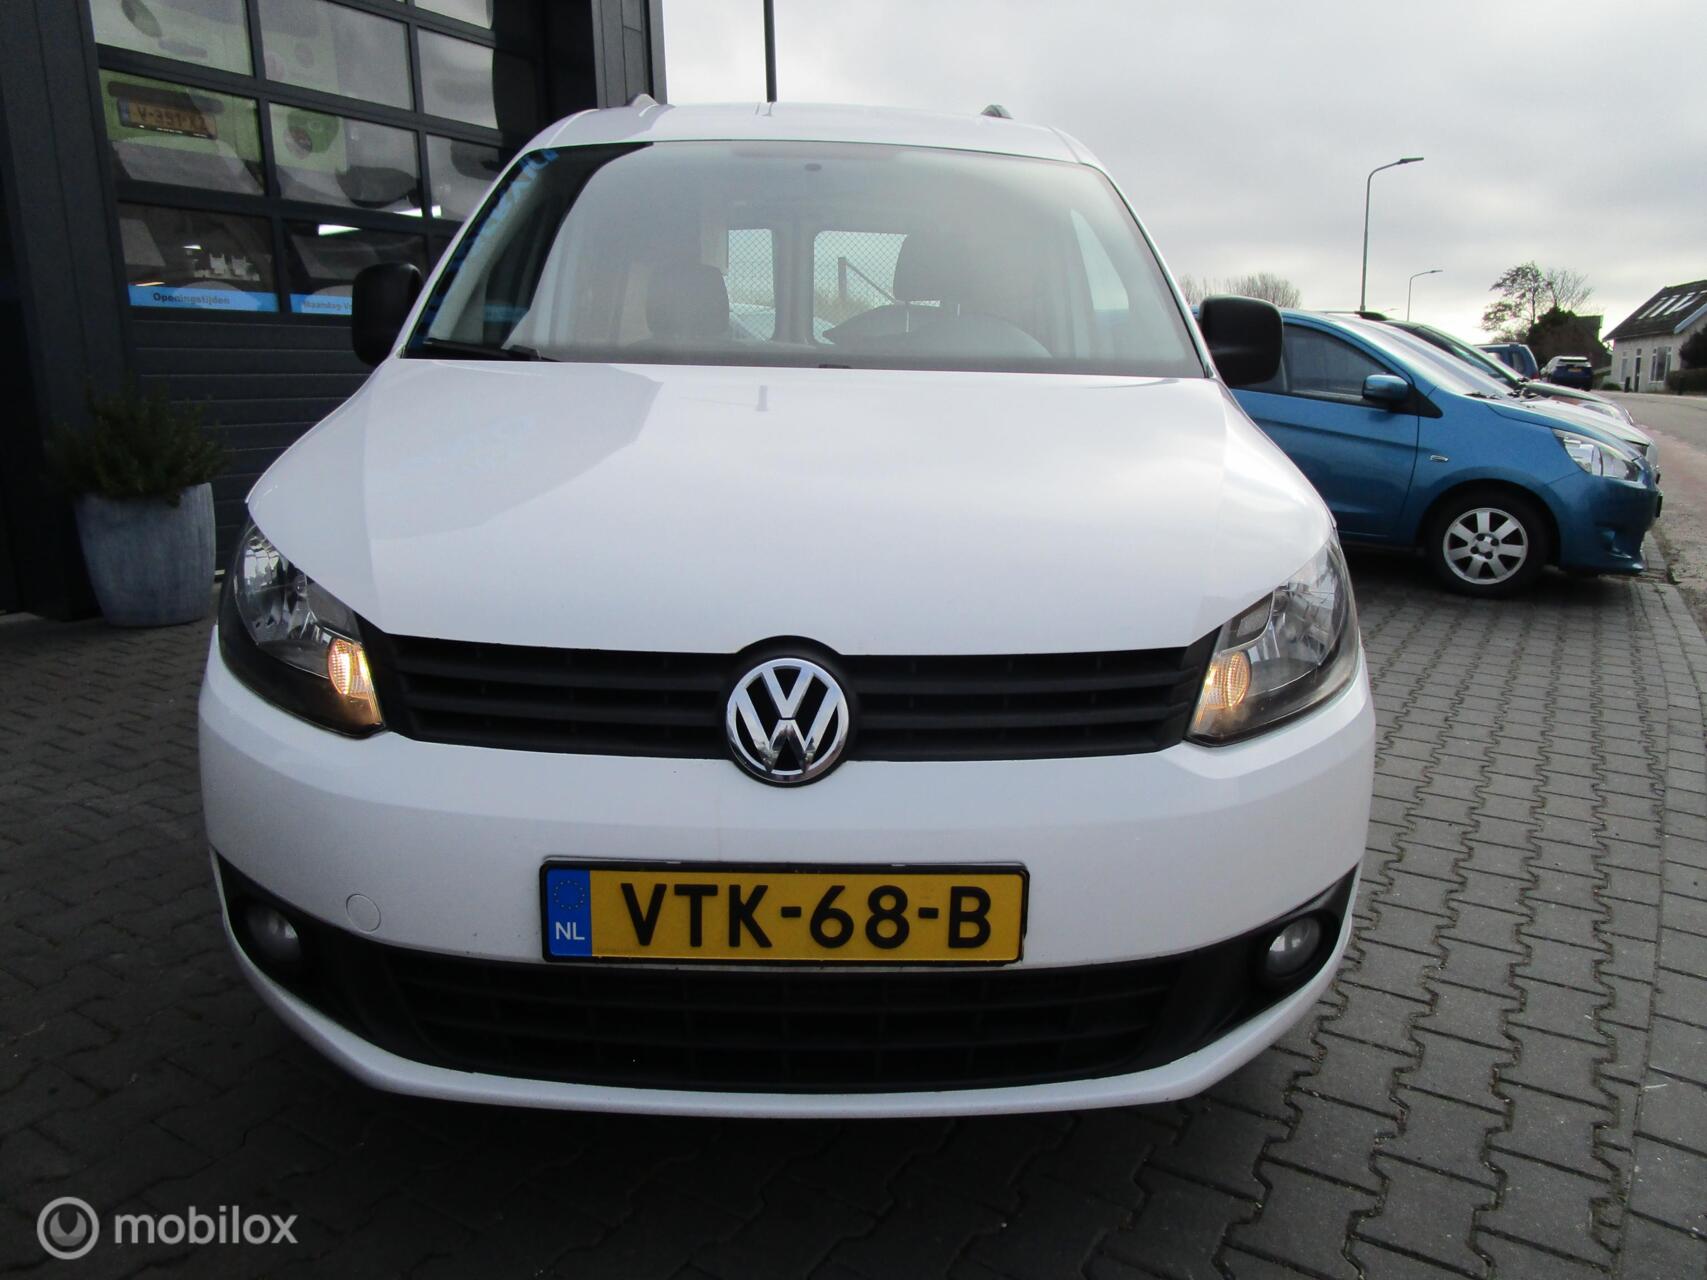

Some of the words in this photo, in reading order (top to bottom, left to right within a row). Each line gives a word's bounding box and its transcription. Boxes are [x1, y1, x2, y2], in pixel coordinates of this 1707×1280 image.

[152, 292, 230, 306] Openingstijden
[620, 882, 992, 950] VTK-68-B
[555, 922, 585, 941] NL
